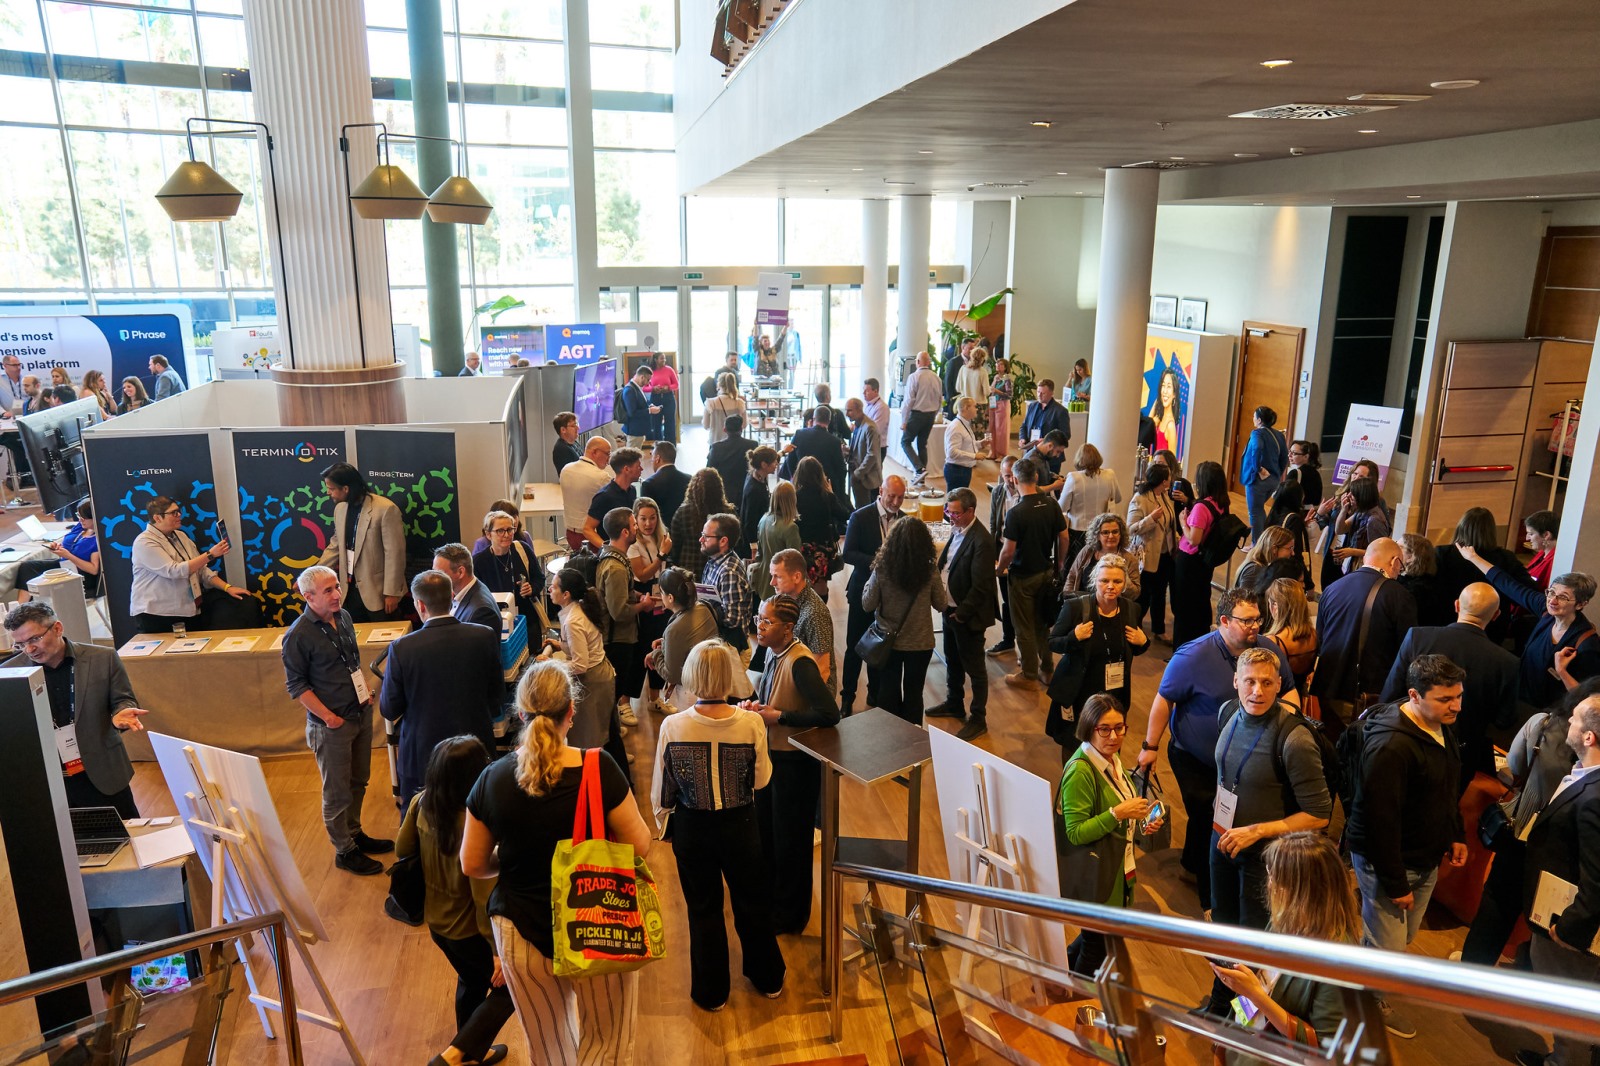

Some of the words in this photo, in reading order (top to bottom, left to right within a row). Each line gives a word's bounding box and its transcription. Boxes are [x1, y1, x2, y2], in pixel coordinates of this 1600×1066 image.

[22, 332, 53, 341] most
[132, 330, 166, 339] Phrase
[559, 345, 594, 359] AGT
[28, 360, 80, 371] platform
[242, 446, 338, 458] TERMINOTIX
[576, 927, 611, 939] PICKLE
[613, 929, 622, 940] IN
